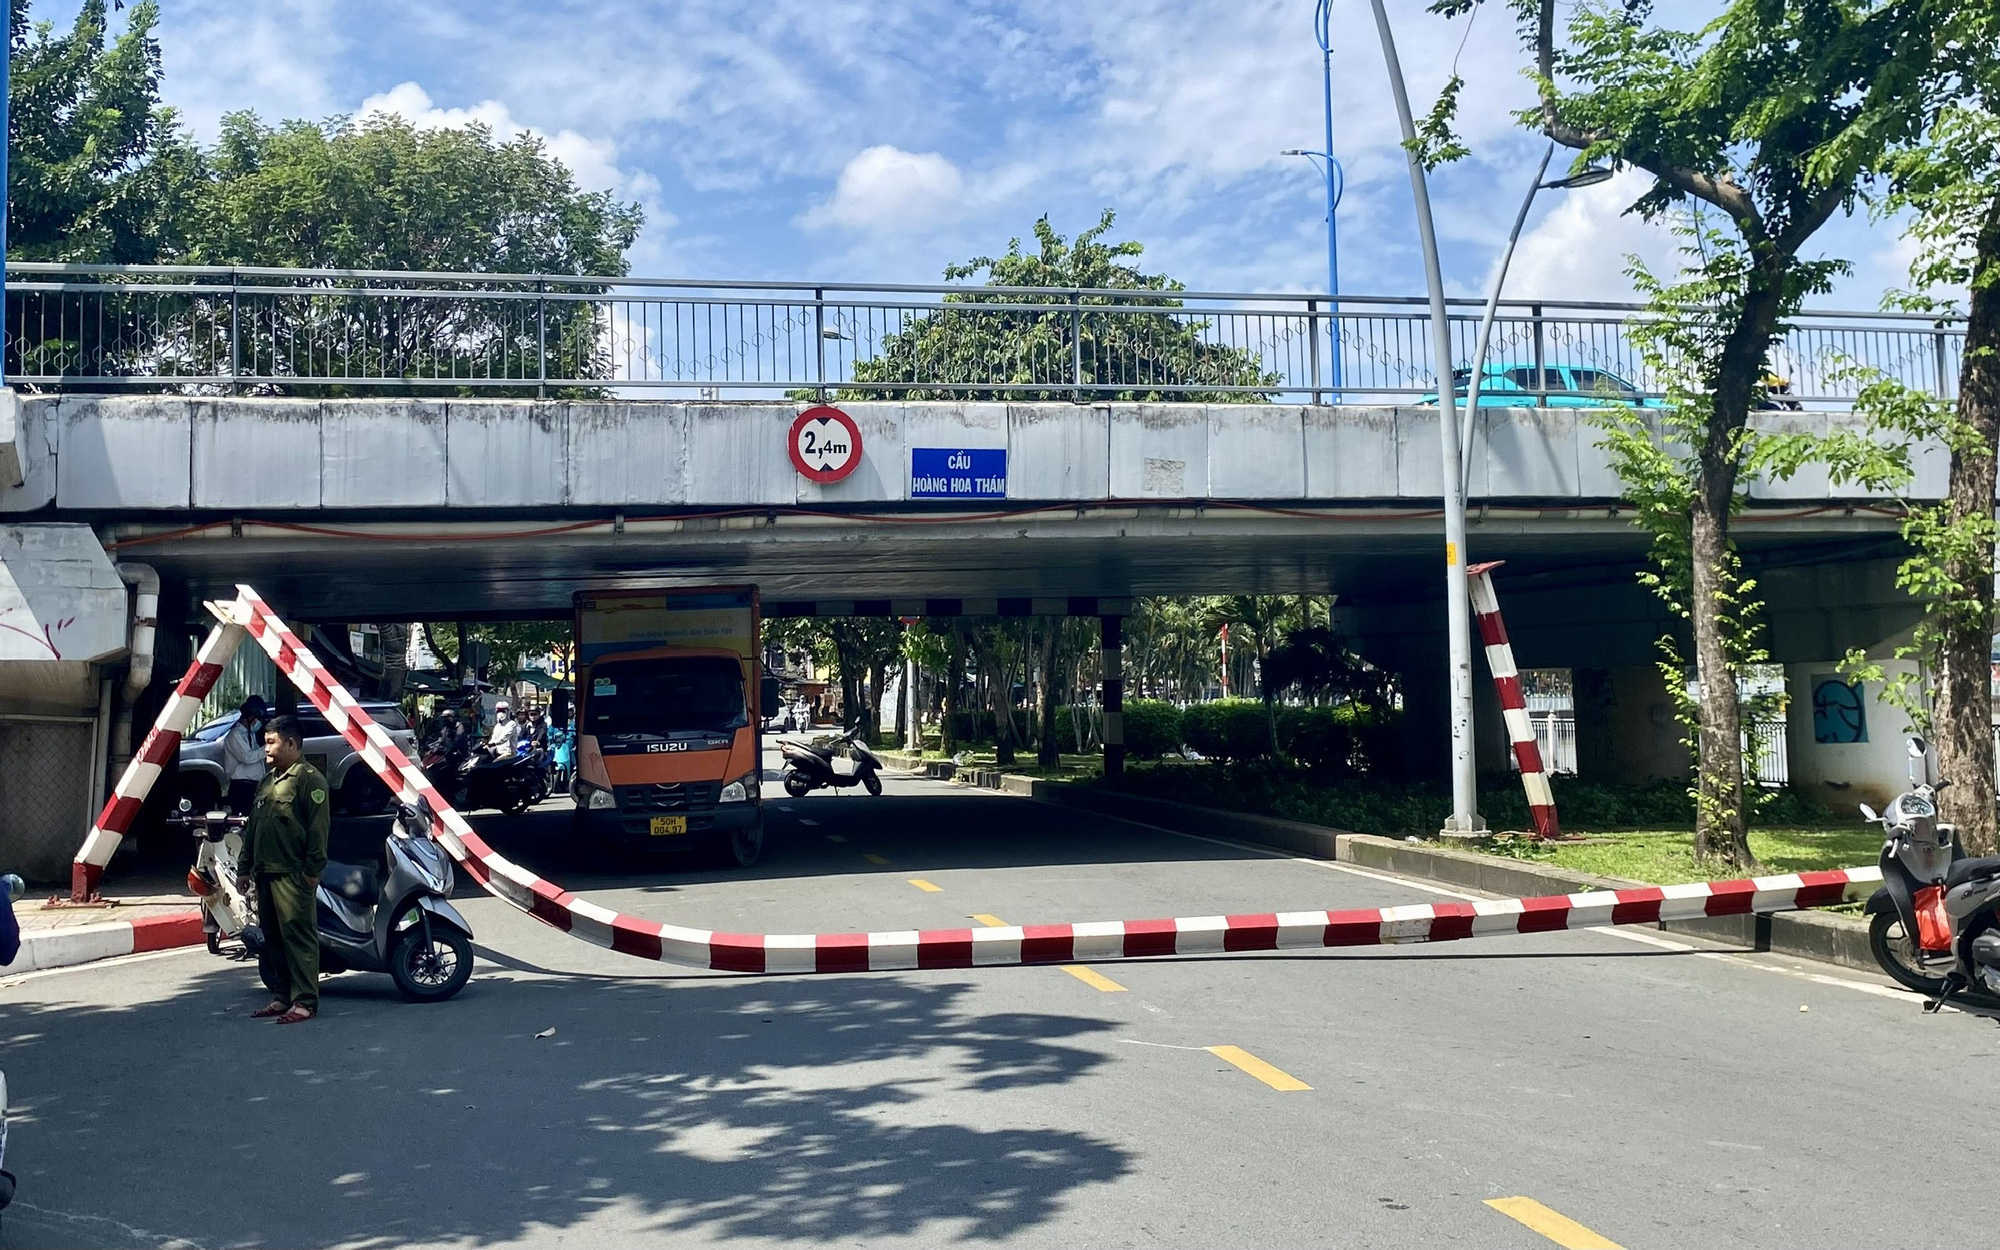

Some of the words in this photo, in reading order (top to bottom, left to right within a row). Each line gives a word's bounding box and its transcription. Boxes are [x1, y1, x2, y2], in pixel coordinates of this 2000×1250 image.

[804, 431, 847, 459] 2,4m
[948, 450, 971, 470] CẦU
[912, 476, 947, 493] HOÀNG
[950, 477, 971, 493] HOA
[975, 474, 1005, 494] THÁM
[647, 742, 688, 753] ISUZU
[660, 817, 676, 826] 50H
